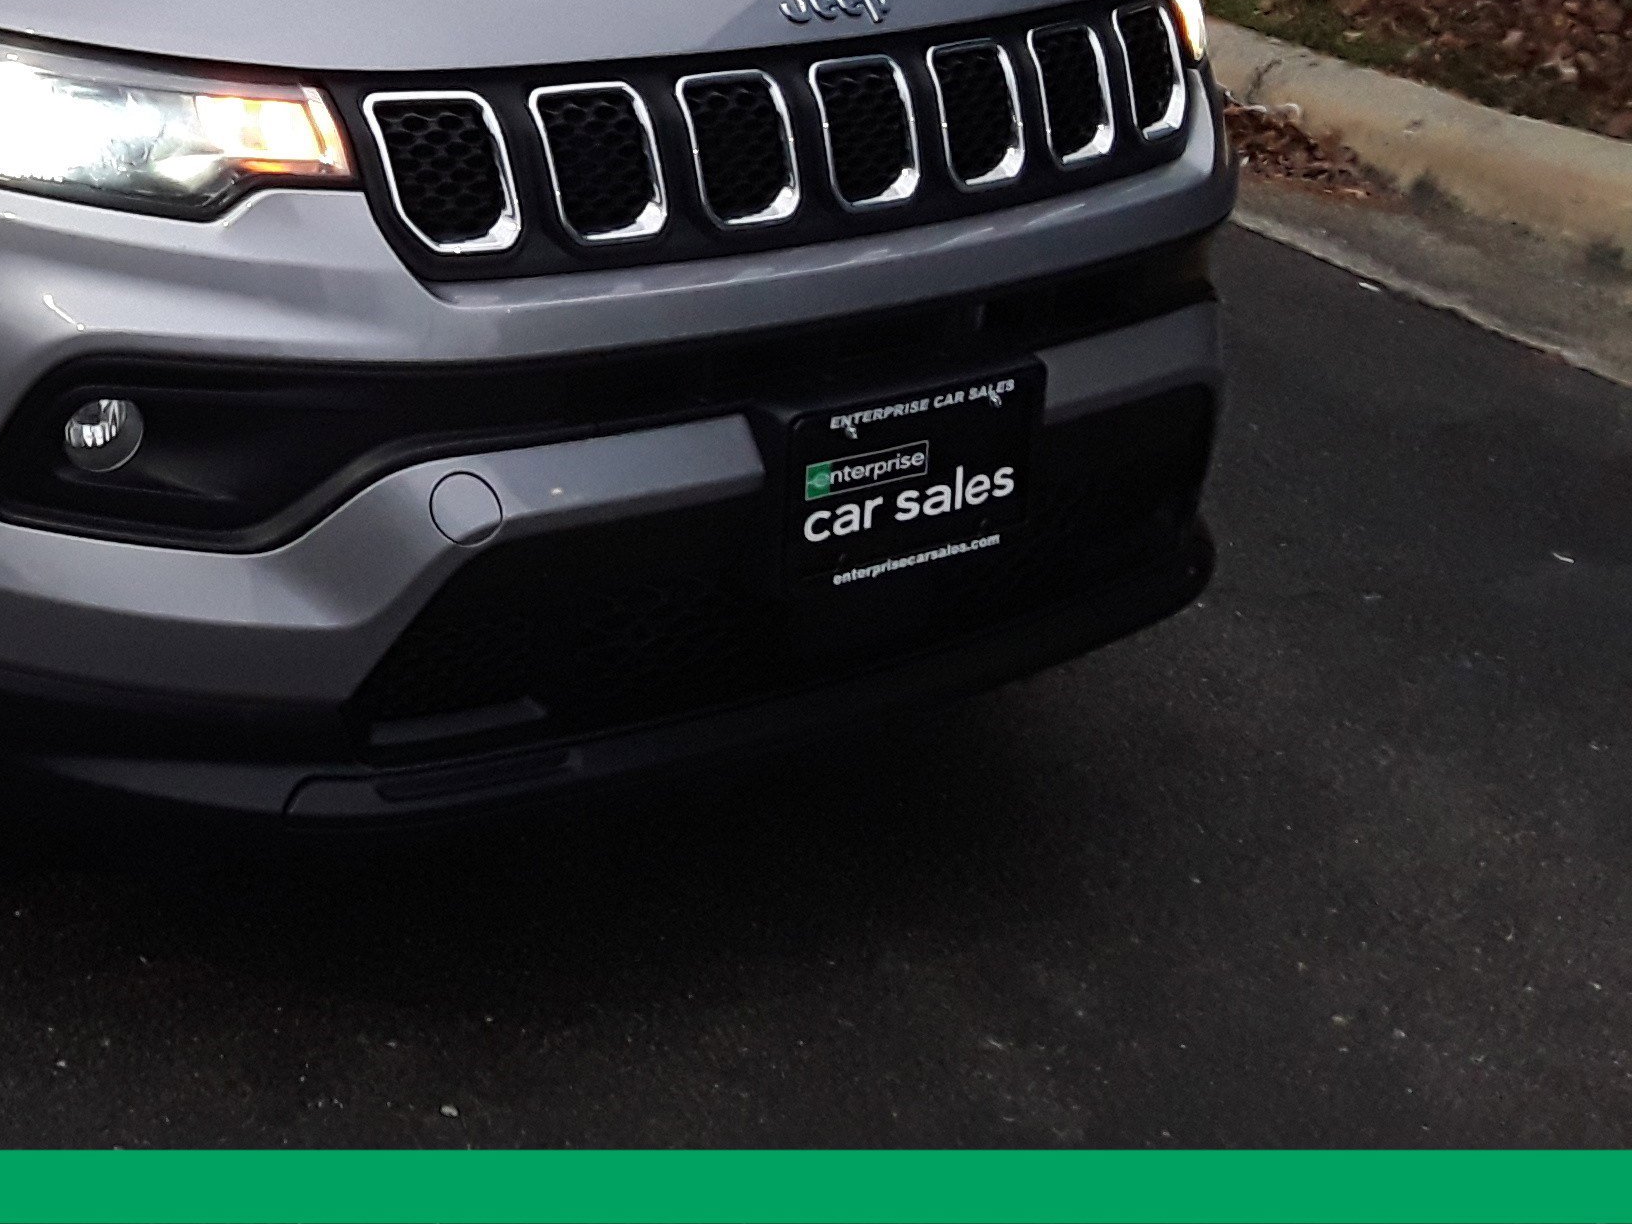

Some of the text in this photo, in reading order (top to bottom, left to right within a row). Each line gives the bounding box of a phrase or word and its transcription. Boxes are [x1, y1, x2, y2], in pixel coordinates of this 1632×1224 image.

[830, 379, 1015, 430] ENTERPRISE CAR SALES
[808, 451, 925, 487] enterprise
[804, 465, 1015, 542] car sales
[833, 534, 1001, 585] enterprisecarsales.com
